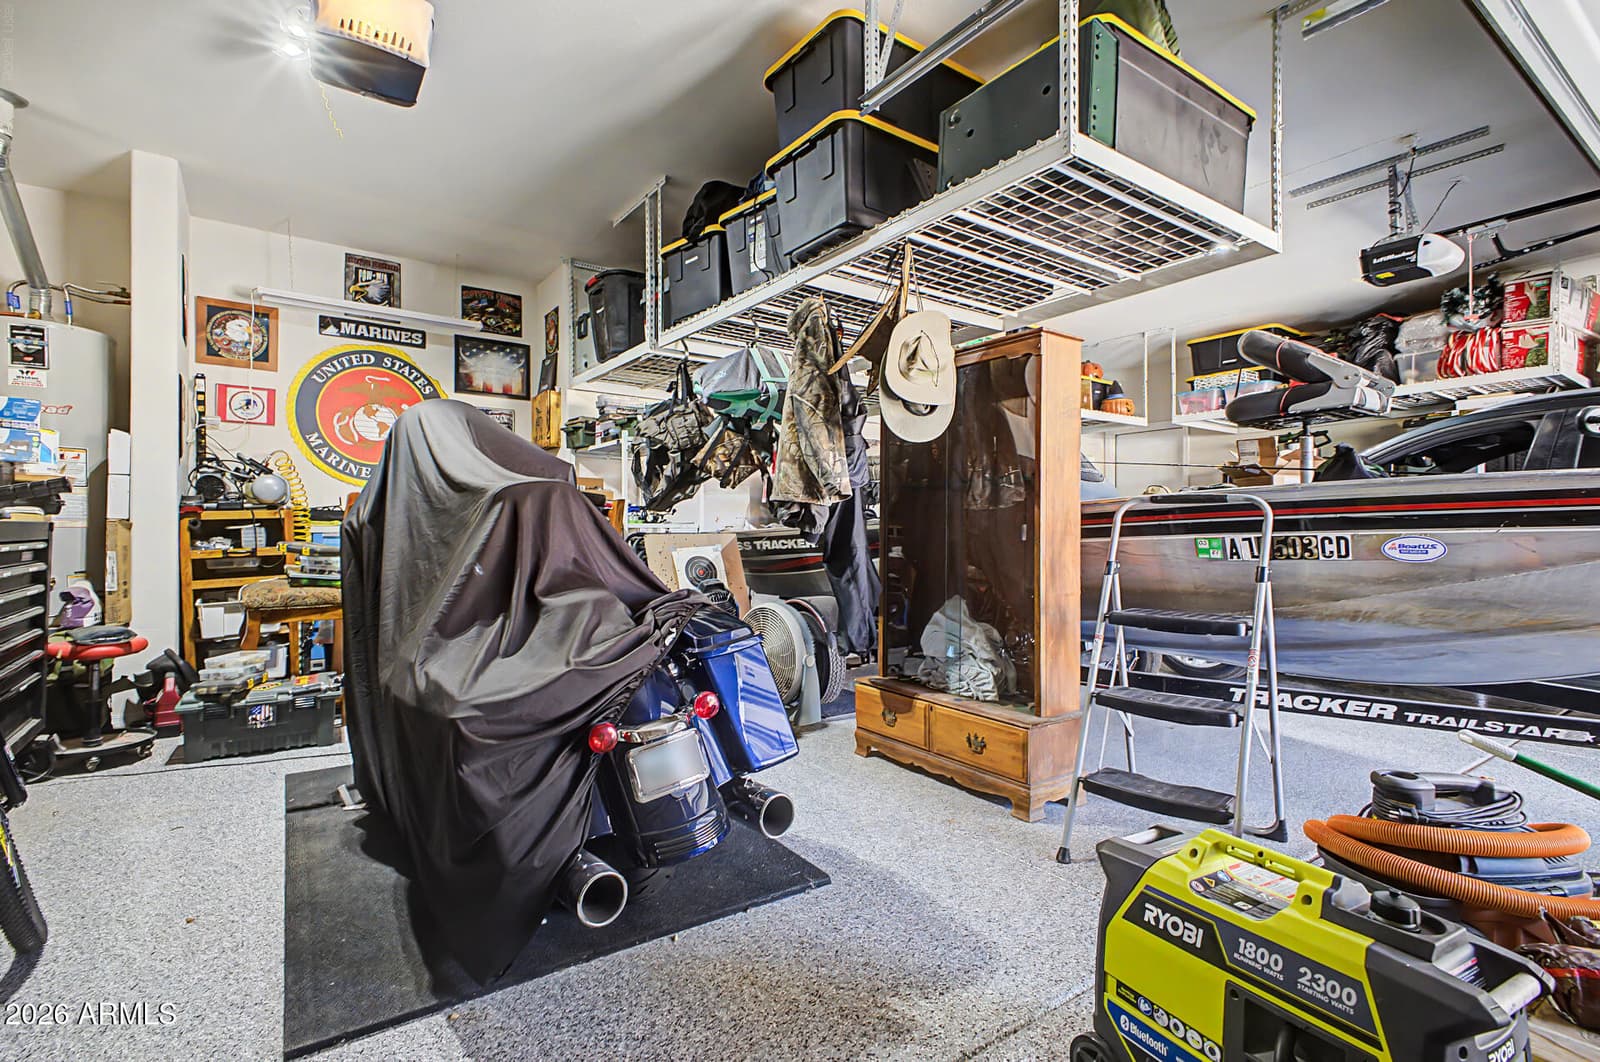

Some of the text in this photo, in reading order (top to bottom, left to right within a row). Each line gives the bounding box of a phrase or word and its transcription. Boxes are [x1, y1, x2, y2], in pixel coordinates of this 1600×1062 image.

[340, 321, 423, 345] MARINES
[311, 353, 434, 395] UNITED STATES
[305, 432, 372, 479] MARINE
[1143, 902, 1204, 948] RYOBI
[1238, 937, 1358, 1007] 1800 2300
[1263, 966, 1284, 981] WATTS
[1297, 983, 1355, 1015] STARTING WATTS
[1129, 1021, 1168, 1056] Bluetooth
